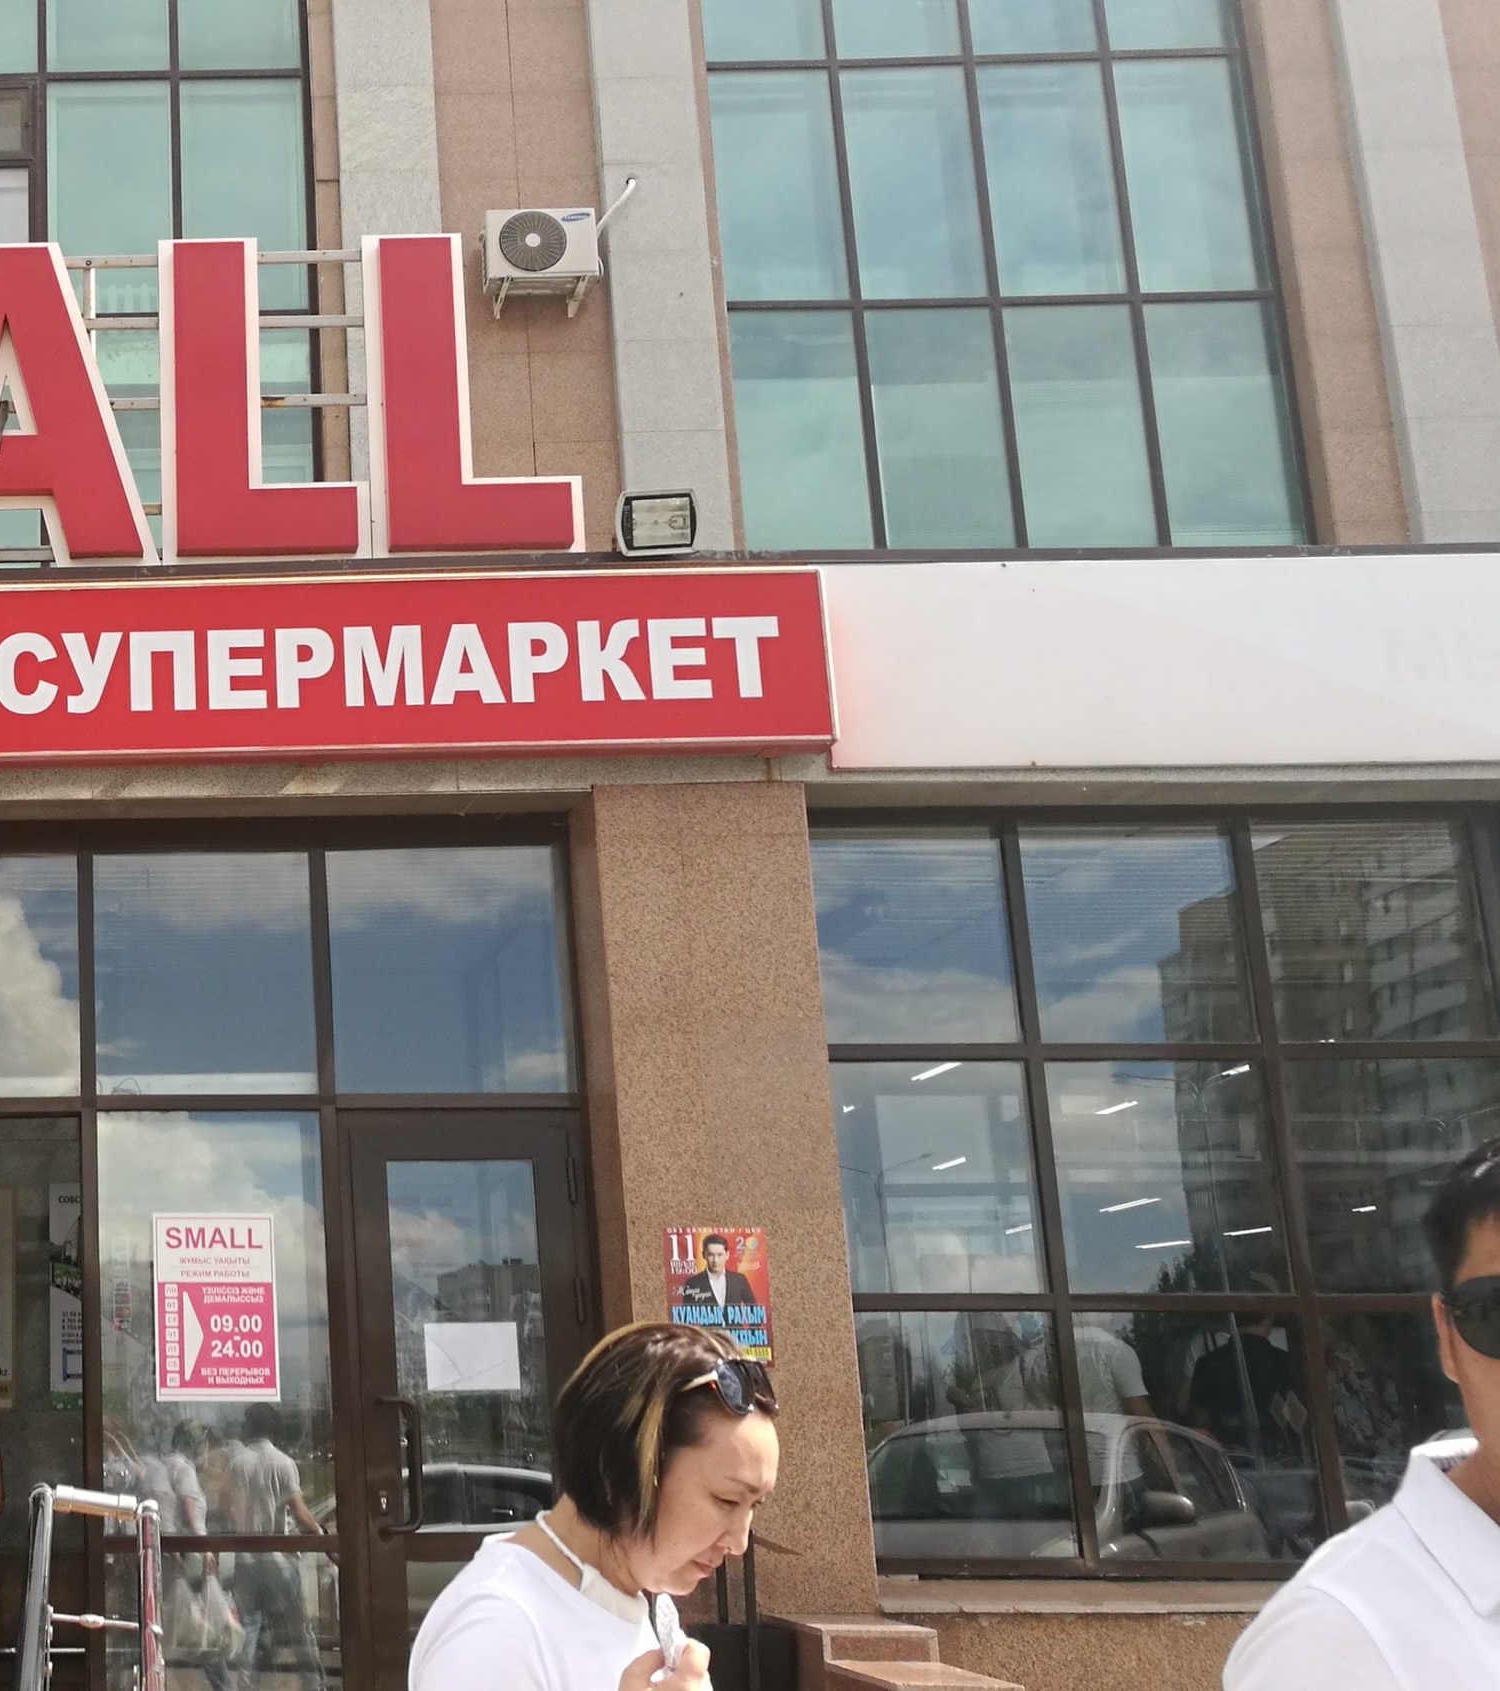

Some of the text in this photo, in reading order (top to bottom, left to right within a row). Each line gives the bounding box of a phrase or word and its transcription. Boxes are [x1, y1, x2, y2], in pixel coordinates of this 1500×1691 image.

[58, 1195, 80, 1204] СОБС
[165, 1227, 263, 1249] SMALL
[669, 1234, 696, 1261] 11
[203, 1295, 264, 1304] ДЕМАЛЫССЫЗ
[210, 1314, 263, 1333] 09.00
[727, 1305, 767, 1325] РАХЫМ
[211, 1340, 263, 1358] 24.00
[201, 1367, 271, 1376] БЕЗ ПЕРЕРЫВОВ
[216, 1376, 264, 1385] ВЫХОДНЫХ
